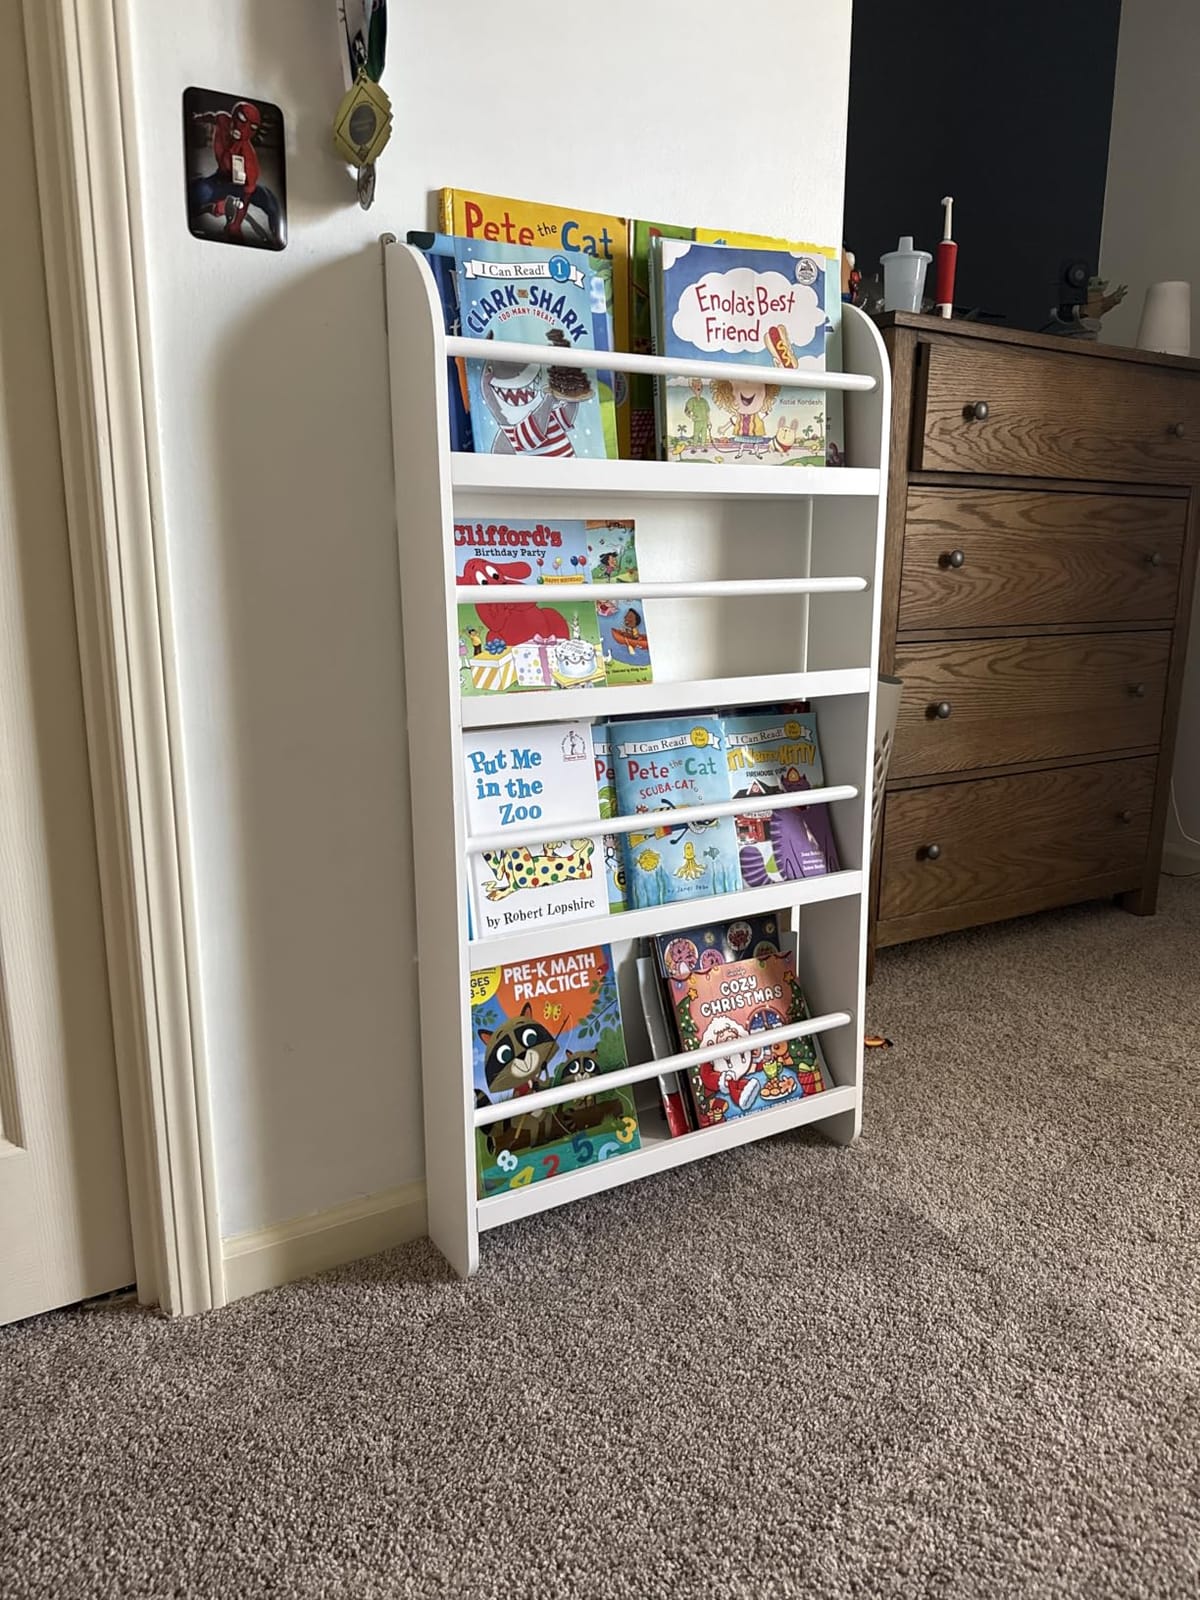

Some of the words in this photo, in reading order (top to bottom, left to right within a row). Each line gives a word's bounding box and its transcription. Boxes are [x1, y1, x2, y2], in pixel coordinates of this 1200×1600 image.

[464, 201, 534, 246] Pete
[537, 217, 557, 237] the
[561, 221, 613, 259] Cat
[481, 263, 486, 275] I
[489, 264, 512, 277] Can
[514, 264, 546, 277] Read!
[556, 262, 563, 275] 1
[512, 307, 531, 315] MANY
[695, 283, 755, 317] Enola's
[755, 286, 796, 316] Best
[467, 285, 519, 333] CLARK
[529, 285, 589, 342] SHARK
[705, 317, 761, 343] Friend
[453, 524, 563, 547] Clifford's
[474, 548, 519, 558] Birthday
[521, 548, 547, 558] Party
[639, 743, 659, 753] Can
[661, 736, 688, 750] Read!
[741, 735, 759, 744] Can
[760, 729, 784, 741] Read!
[468, 750, 507, 775] Put
[511, 749, 542, 770] Me
[594, 759, 615, 781] Pe
[627, 760, 670, 782] Pete
[669, 759, 683, 769] the
[685, 757, 717, 775] Cat
[476, 778, 501, 799] in
[505, 778, 543, 799] the
[639, 779, 695, 800] SCUBA-CAT
[500, 803, 542, 825] Zoo
[486, 915, 501, 929] by
[504, 906, 543, 925] Robert
[547, 898, 595, 916] Lopshire
[503, 963, 548, 985] PRE-K
[550, 952, 596, 976] MATH
[470, 976, 490, 988] GES
[513, 971, 590, 1001] PRACTICE
[720, 974, 758, 996] COZY
[700, 984, 783, 1017] CHRISTMAS
[616, 1116, 637, 1143] 3
[571, 1132, 594, 1163] 5
[497, 1149, 518, 1172] 8
[542, 1155, 560, 1178] 2
[509, 1165, 535, 1188] 4
